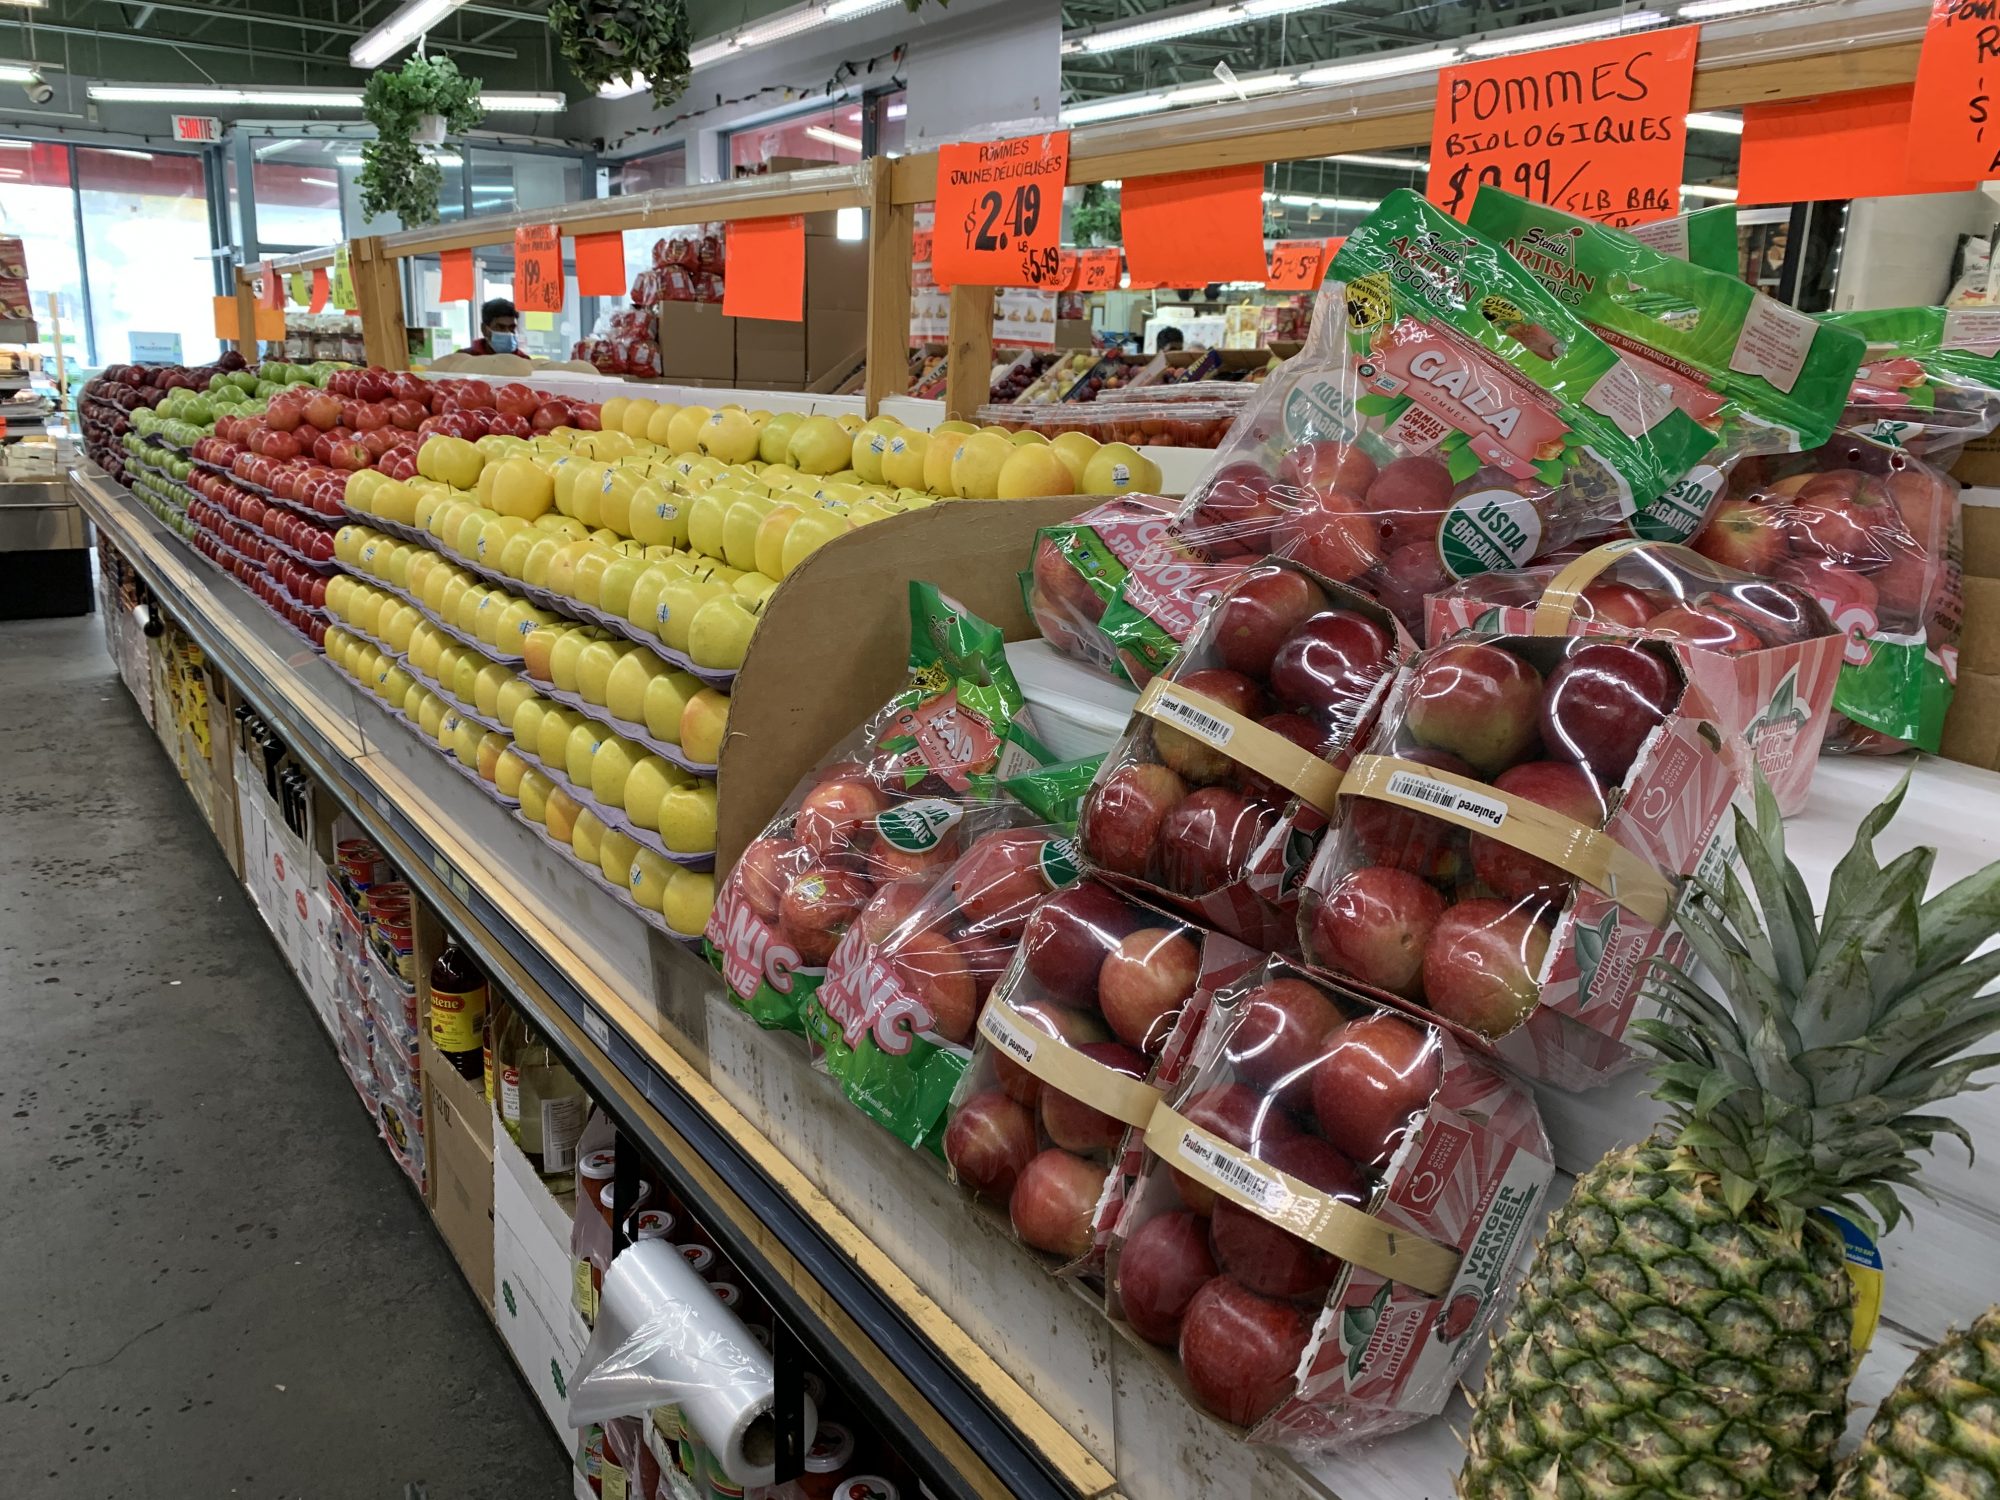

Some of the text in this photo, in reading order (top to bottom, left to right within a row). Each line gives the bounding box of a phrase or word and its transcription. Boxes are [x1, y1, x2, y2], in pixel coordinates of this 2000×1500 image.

[1450, 51, 1650, 125] POMMES
[178, 117, 214, 140] SORTIE
[1446, 115, 1673, 159] BIOLOGIQUES
[979, 140, 1030, 163] POMMES
[951, 167, 992, 186] JAUNES
[964, 183, 1041, 251] $2.49
[1627, 187, 1670, 211] BAG
[1521, 227, 1569, 257] Stemilt
[1022, 247, 1059, 284] $5.49
[1388, 236, 1478, 303] ARTISAN
[1503, 238, 1595, 293] ARTISAN
[1534, 273, 1583, 306] anics
[1409, 350, 1522, 440] GALA
[1403, 414, 1439, 440] OWNED
[1410, 407, 1448, 434] FAMILY
[1668, 479, 1714, 512] SDA
[1477, 500, 1529, 554] USDA
[1647, 500, 1699, 535] RGANIC
[1456, 798, 1503, 824] Paulared
[1693, 813, 1719, 856] 3 Litres
[1588, 923, 1623, 998] Pommes
[1609, 936, 1646, 1010] fantaisie
[1610, 956, 1625, 980] de
[432, 997, 459, 1009] stene
[1005, 1037, 1034, 1062] Paulared
[1428, 1132, 1448, 1167] POMMES
[1472, 1178, 1498, 1224] 3 Litres
[1463, 1184, 1515, 1277] VERGER
[1476, 1190, 1528, 1280] HAMEL
[1359, 1304, 1396, 1375] Pommes
[1381, 1331, 1398, 1354] de
[1382, 1309, 1422, 1381] fantaisie
